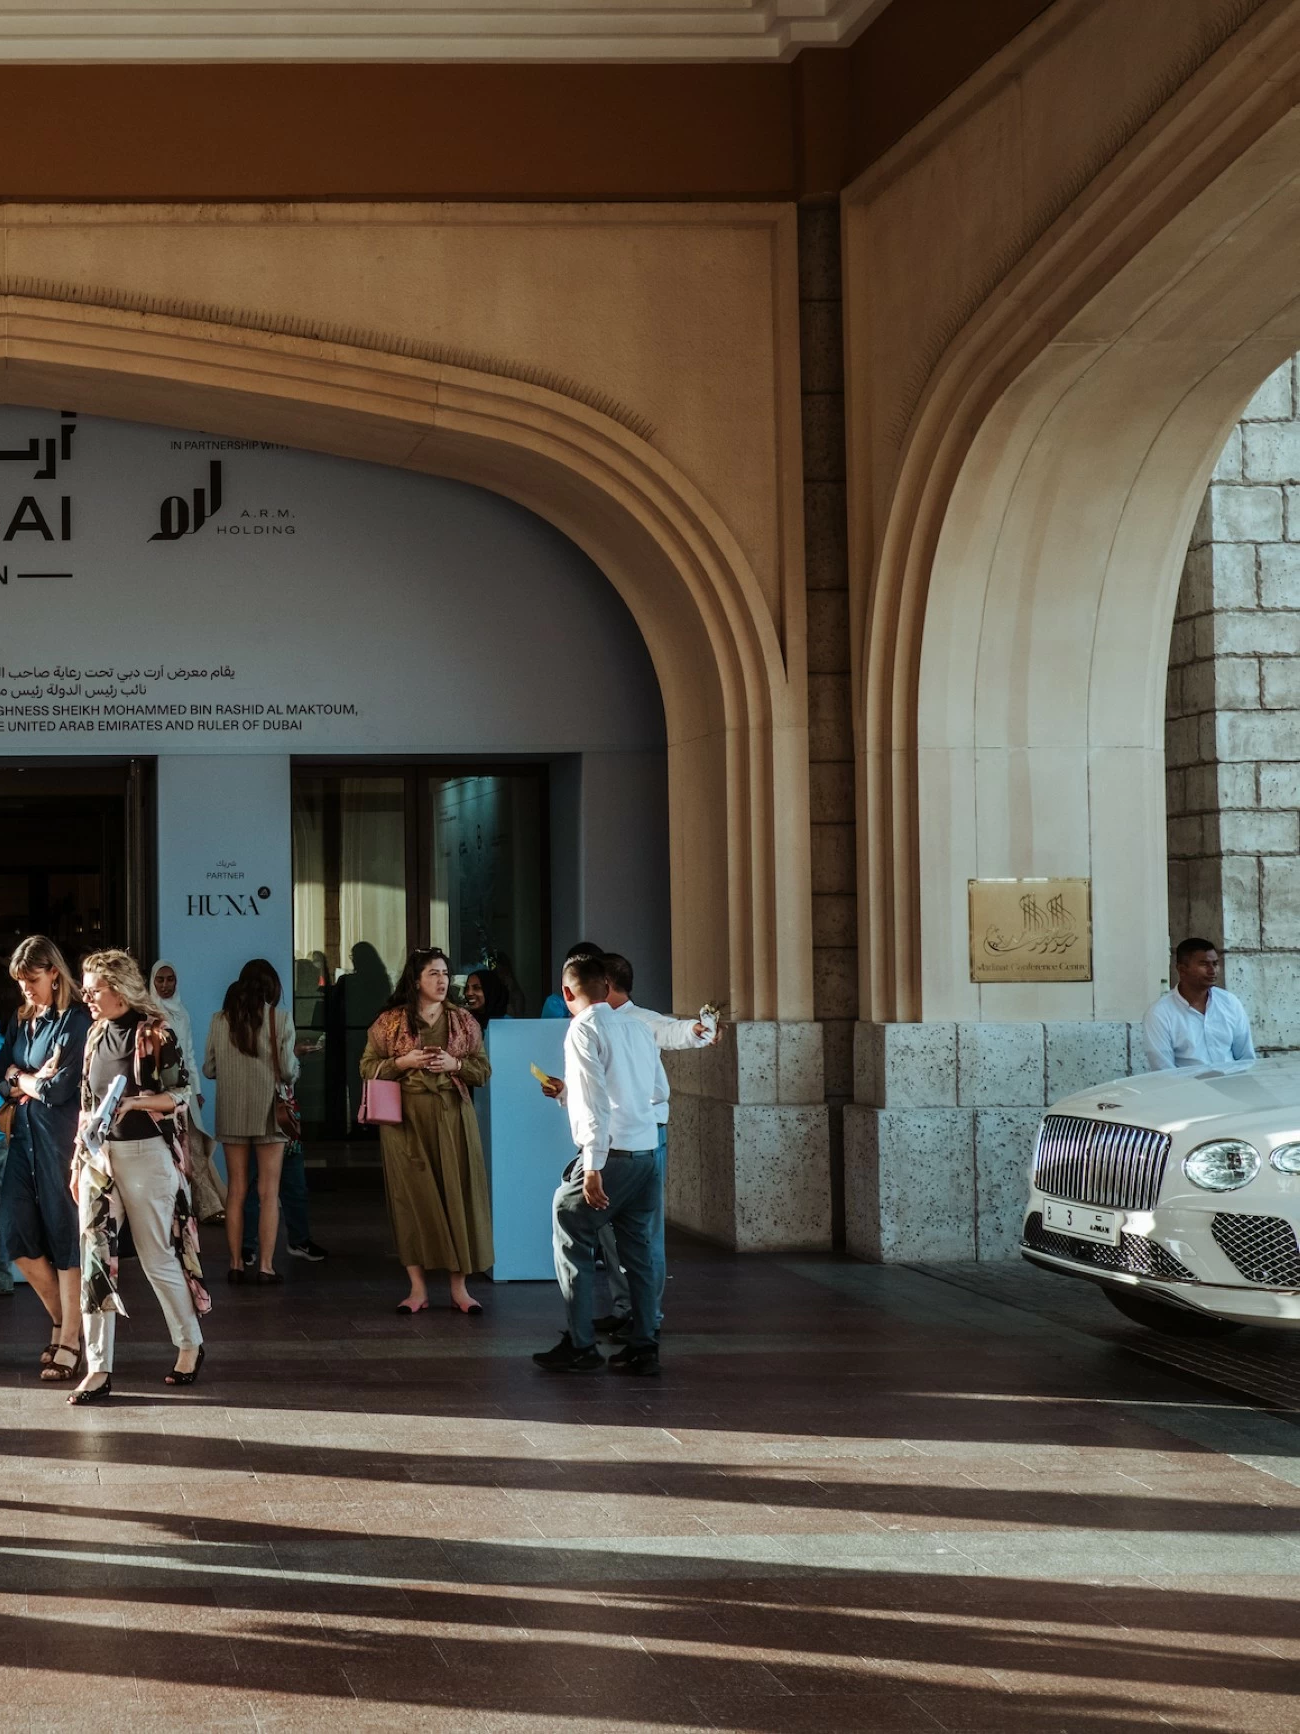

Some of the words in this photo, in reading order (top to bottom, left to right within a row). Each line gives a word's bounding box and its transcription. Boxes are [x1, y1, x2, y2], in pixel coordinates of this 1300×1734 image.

[170, 441, 181, 450] IN
[184, 440, 259, 450] PARTNERSHIP
[261, 441, 290, 450] WI
[217, 525, 296, 535] HOLDING
[8, 667, 50, 681] صاحب
[53, 666, 82, 681] رعاية
[85, 668, 114, 678] تحت
[118, 669, 140, 683] دبي
[167, 668, 208, 680] معرض
[210, 665, 235, 680] يقام
[11, 685, 44, 698] رئيس
[46, 683, 82, 698] الدولة
[85, 684, 118, 698] رئيس
[120, 684, 147, 697] نائب
[52, 705, 100, 716] SHEIKH
[103, 705, 187, 716] MOHAMMED
[190, 705, 212, 716] BIN
[215, 705, 264, 716] RASHID
[266, 704, 283, 715] AL
[286, 704, 358, 716] MAKTOUM,
[8, 721, 56, 732] UNITED
[59, 721, 94, 732] ARAB
[98, 720, 162, 731] EMIRATES
[165, 720, 194, 731] AND
[197, 720, 239, 731] RULER
[242, 720, 260, 731] OF
[263, 720, 302, 731] DUBAI
[206, 872, 245, 880] PARTNER
[186, 894, 260, 916] HUNA
[1067, 1210, 1072, 1226] 3
